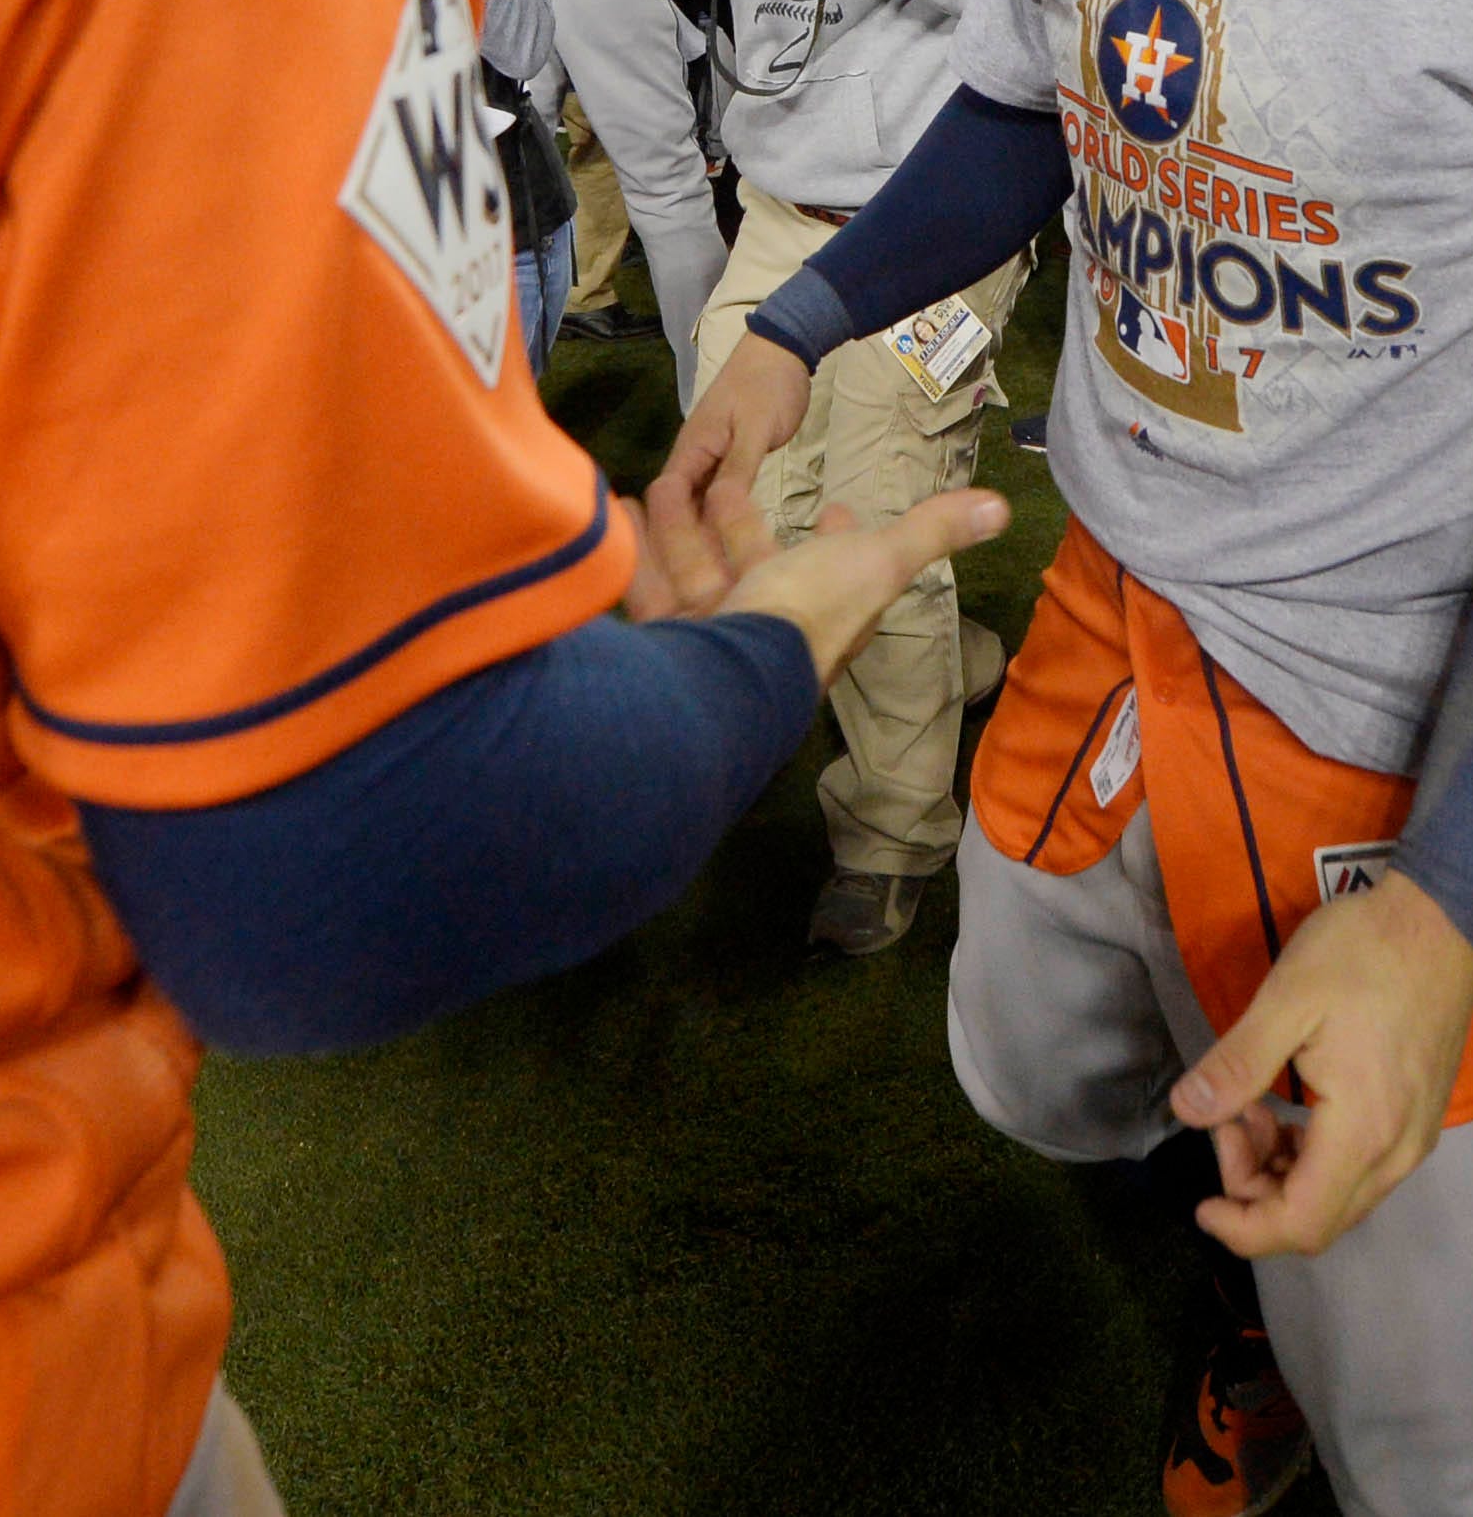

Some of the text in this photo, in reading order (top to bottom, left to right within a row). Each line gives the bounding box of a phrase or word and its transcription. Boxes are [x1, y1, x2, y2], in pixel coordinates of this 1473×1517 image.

[1121, 31, 1178, 108] H
[1061, 109, 1341, 247] ORLD SERIES
[1205, 335, 1266, 379] 17
